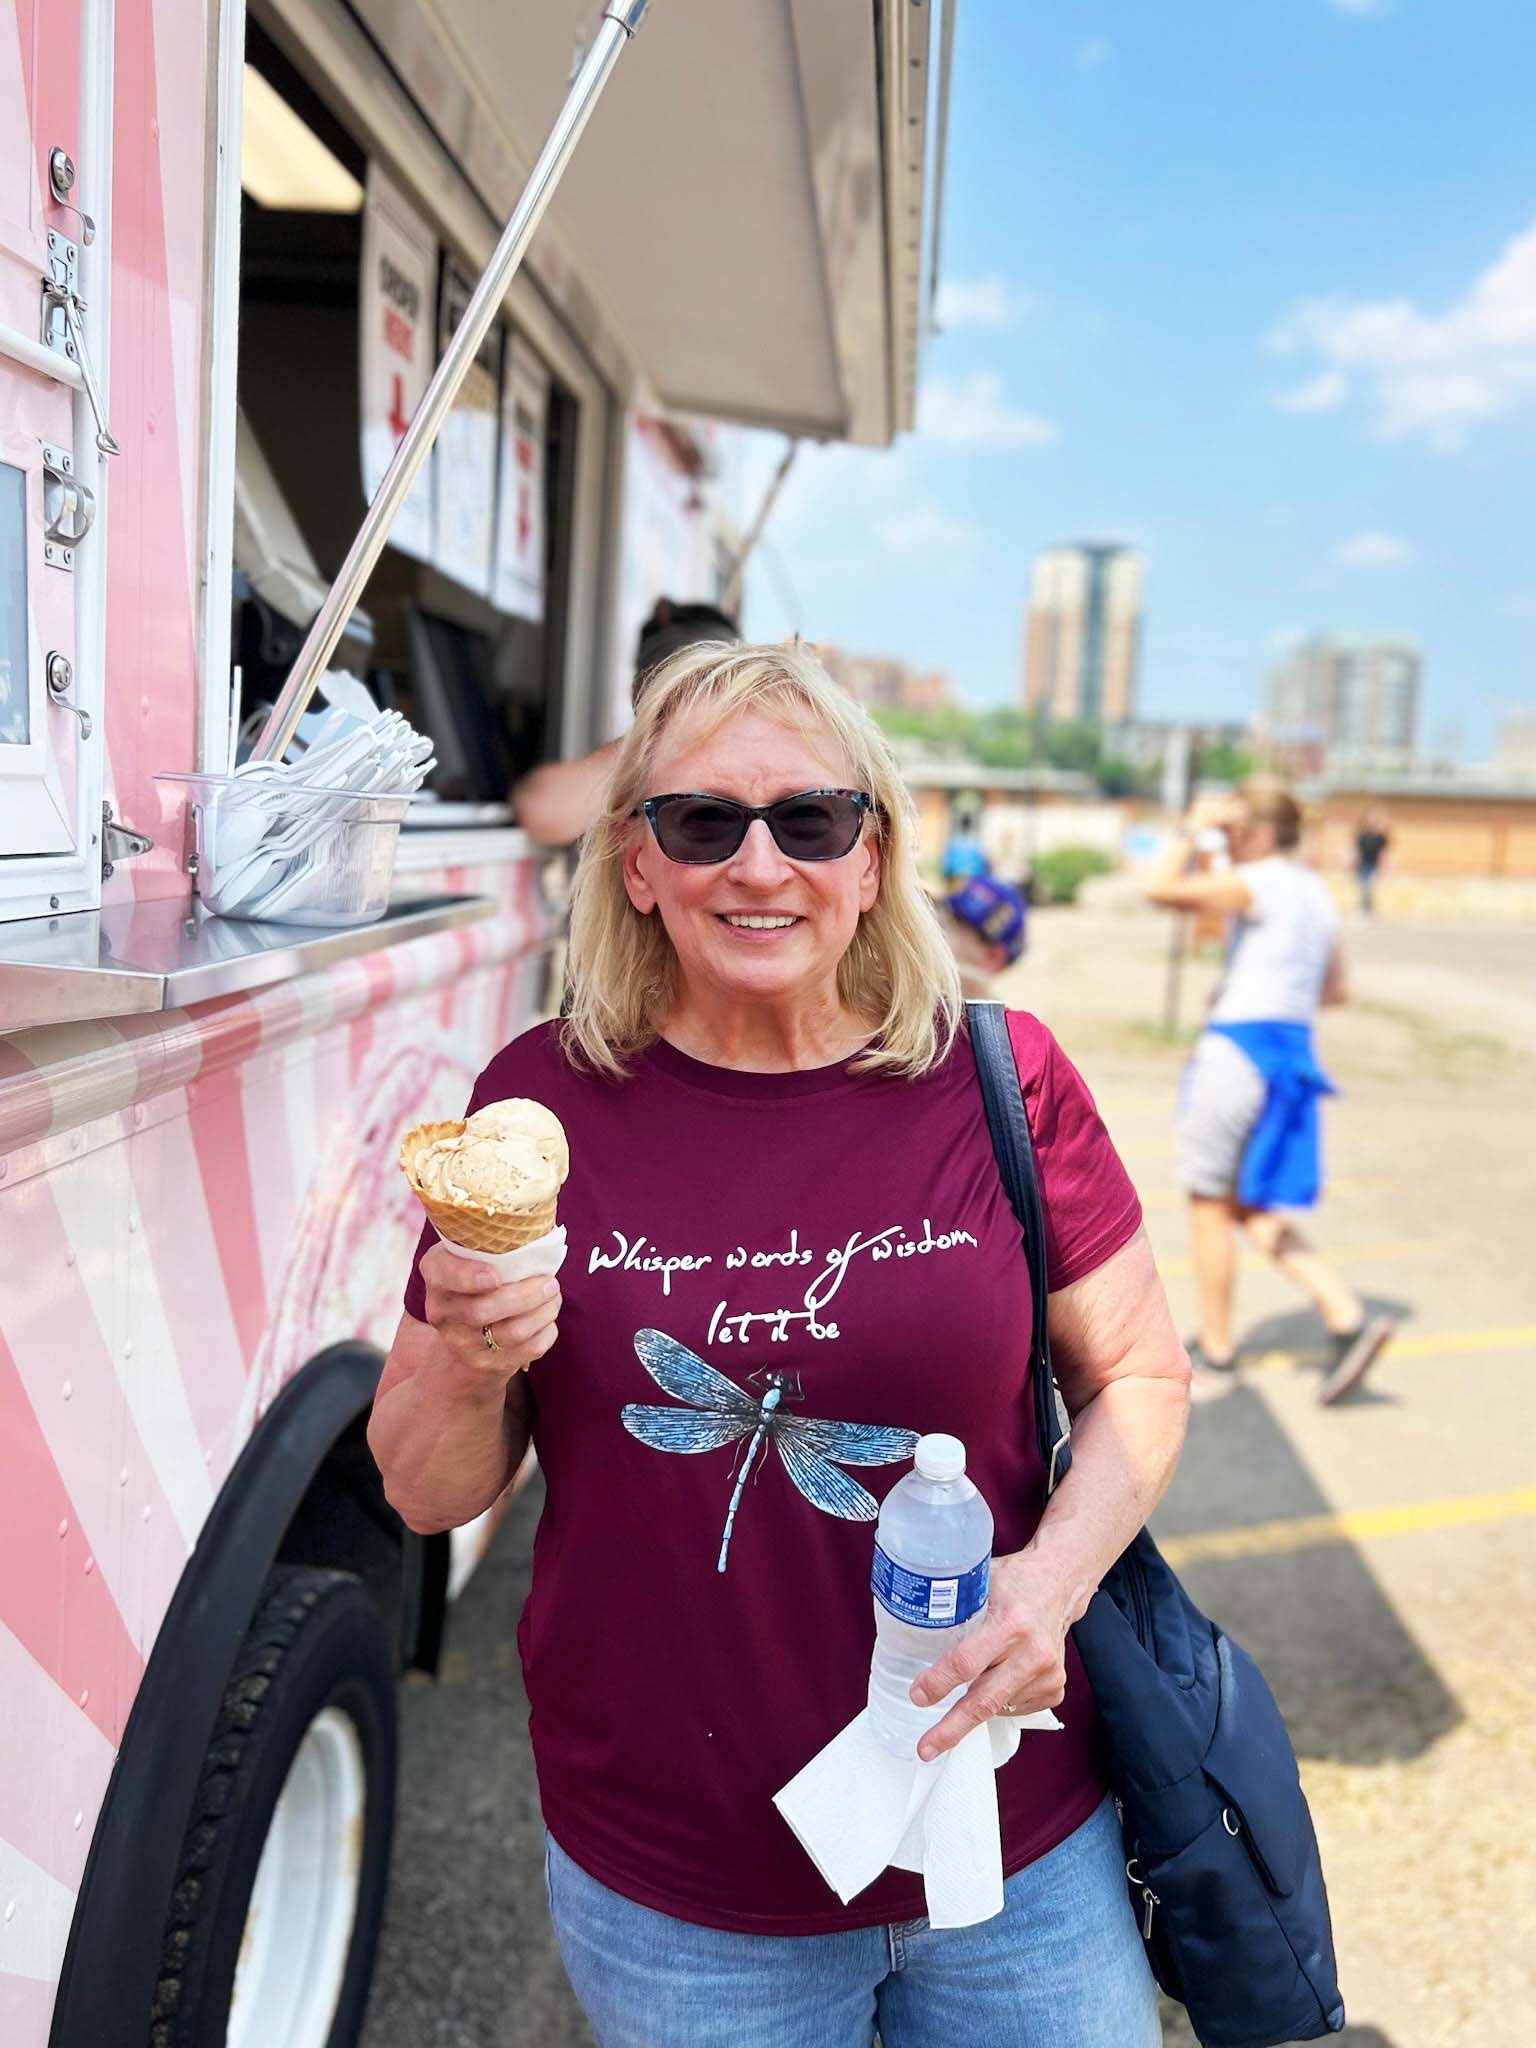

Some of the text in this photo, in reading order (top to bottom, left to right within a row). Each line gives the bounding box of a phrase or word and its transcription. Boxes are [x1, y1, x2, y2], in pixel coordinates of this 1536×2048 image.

[588, 1218, 979, 1311] Whisper words of wisdom
[706, 1296, 841, 1345] let it be
